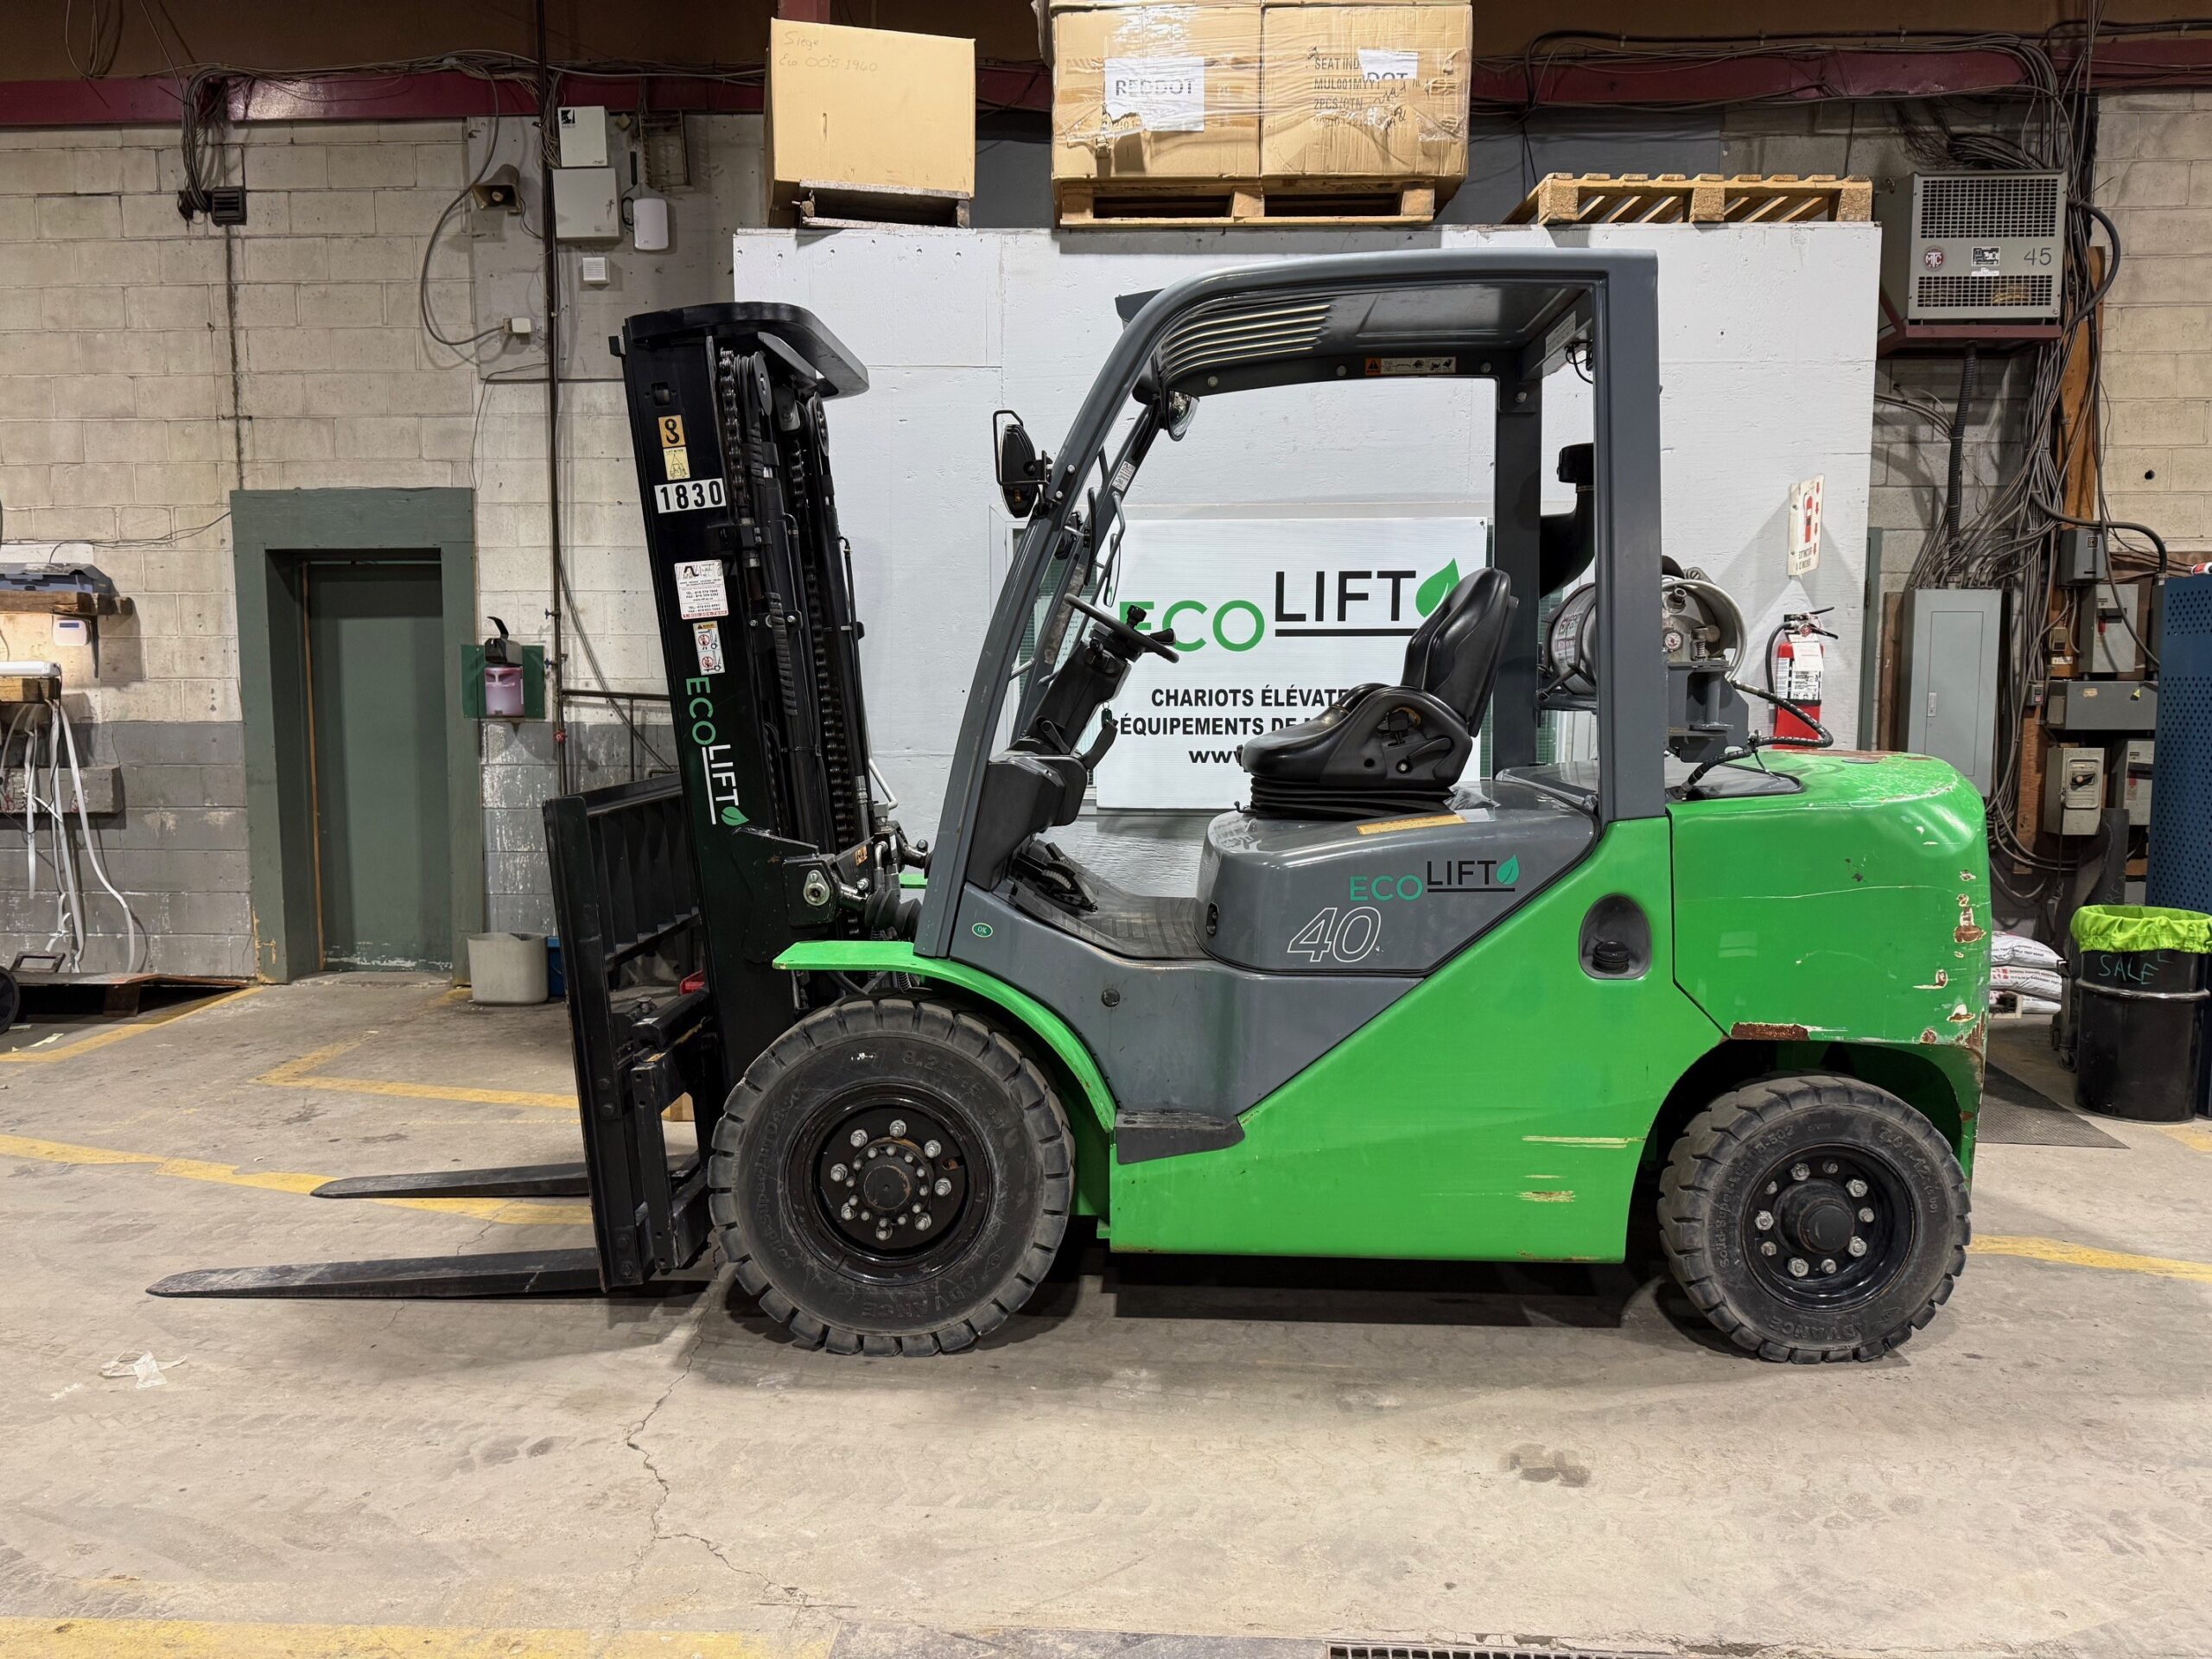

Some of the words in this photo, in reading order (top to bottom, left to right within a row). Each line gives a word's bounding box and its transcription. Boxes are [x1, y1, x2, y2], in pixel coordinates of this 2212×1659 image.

[1314, 57, 1340, 70] SEAT
[1116, 78, 1195, 96] REDDOT
[2024, 248, 2052, 266] 45
[660, 480, 722, 511] 1830
[1119, 600, 1265, 652] ECO
[1274, 570, 1417, 622] LIFT
[1151, 689, 1254, 707] CHARIOTS
[1120, 713, 1264, 736] ÉQUIPEMENTS
[686, 677, 716, 746] ECO
[709, 744, 739, 806] LIFT
[1349, 874, 1424, 901] ECO
[1427, 861, 1497, 886] LIFT
[977, 925, 988, 934] OK
[1287, 906, 1382, 963] 40
[2098, 954, 2159, 984] SALE
